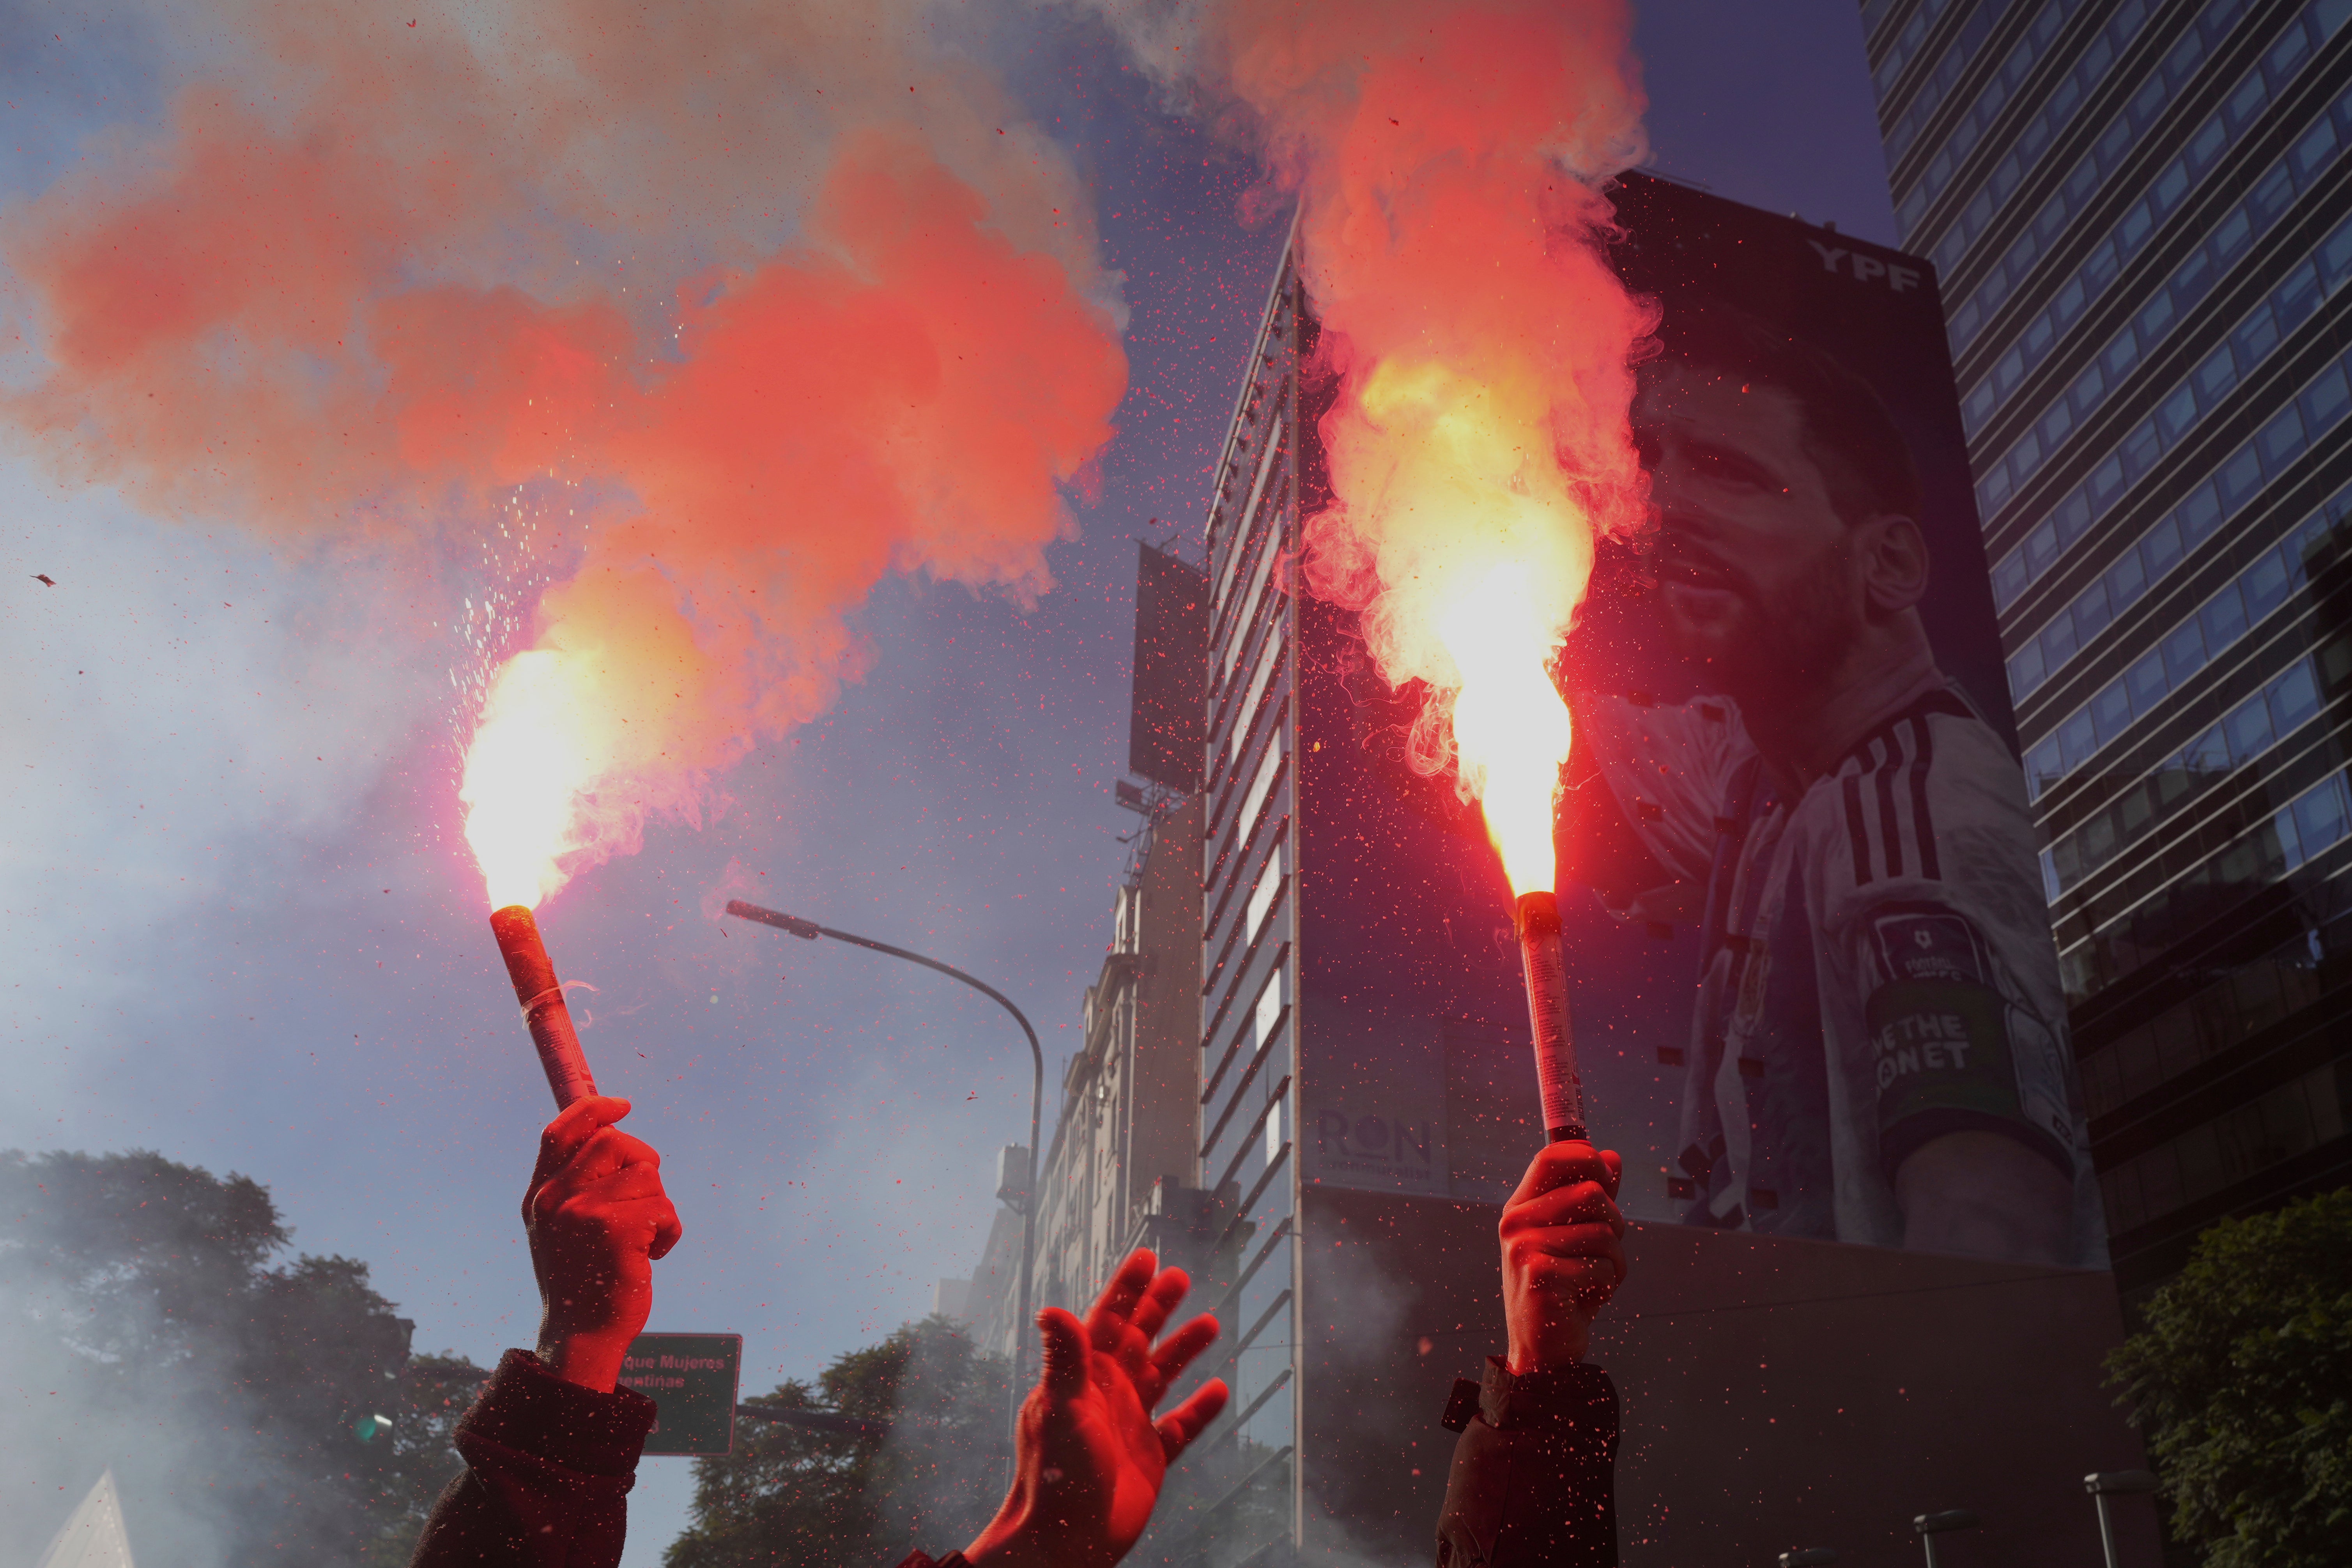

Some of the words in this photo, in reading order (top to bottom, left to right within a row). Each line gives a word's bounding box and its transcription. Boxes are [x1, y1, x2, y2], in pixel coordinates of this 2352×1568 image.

[1806, 238, 1921, 292] YPF
[1896, 1013, 1968, 1040] THE
[1318, 1108, 1430, 1164] RON
[623, 1357, 655, 1371] que
[660, 1354, 725, 1372] Mujeres
